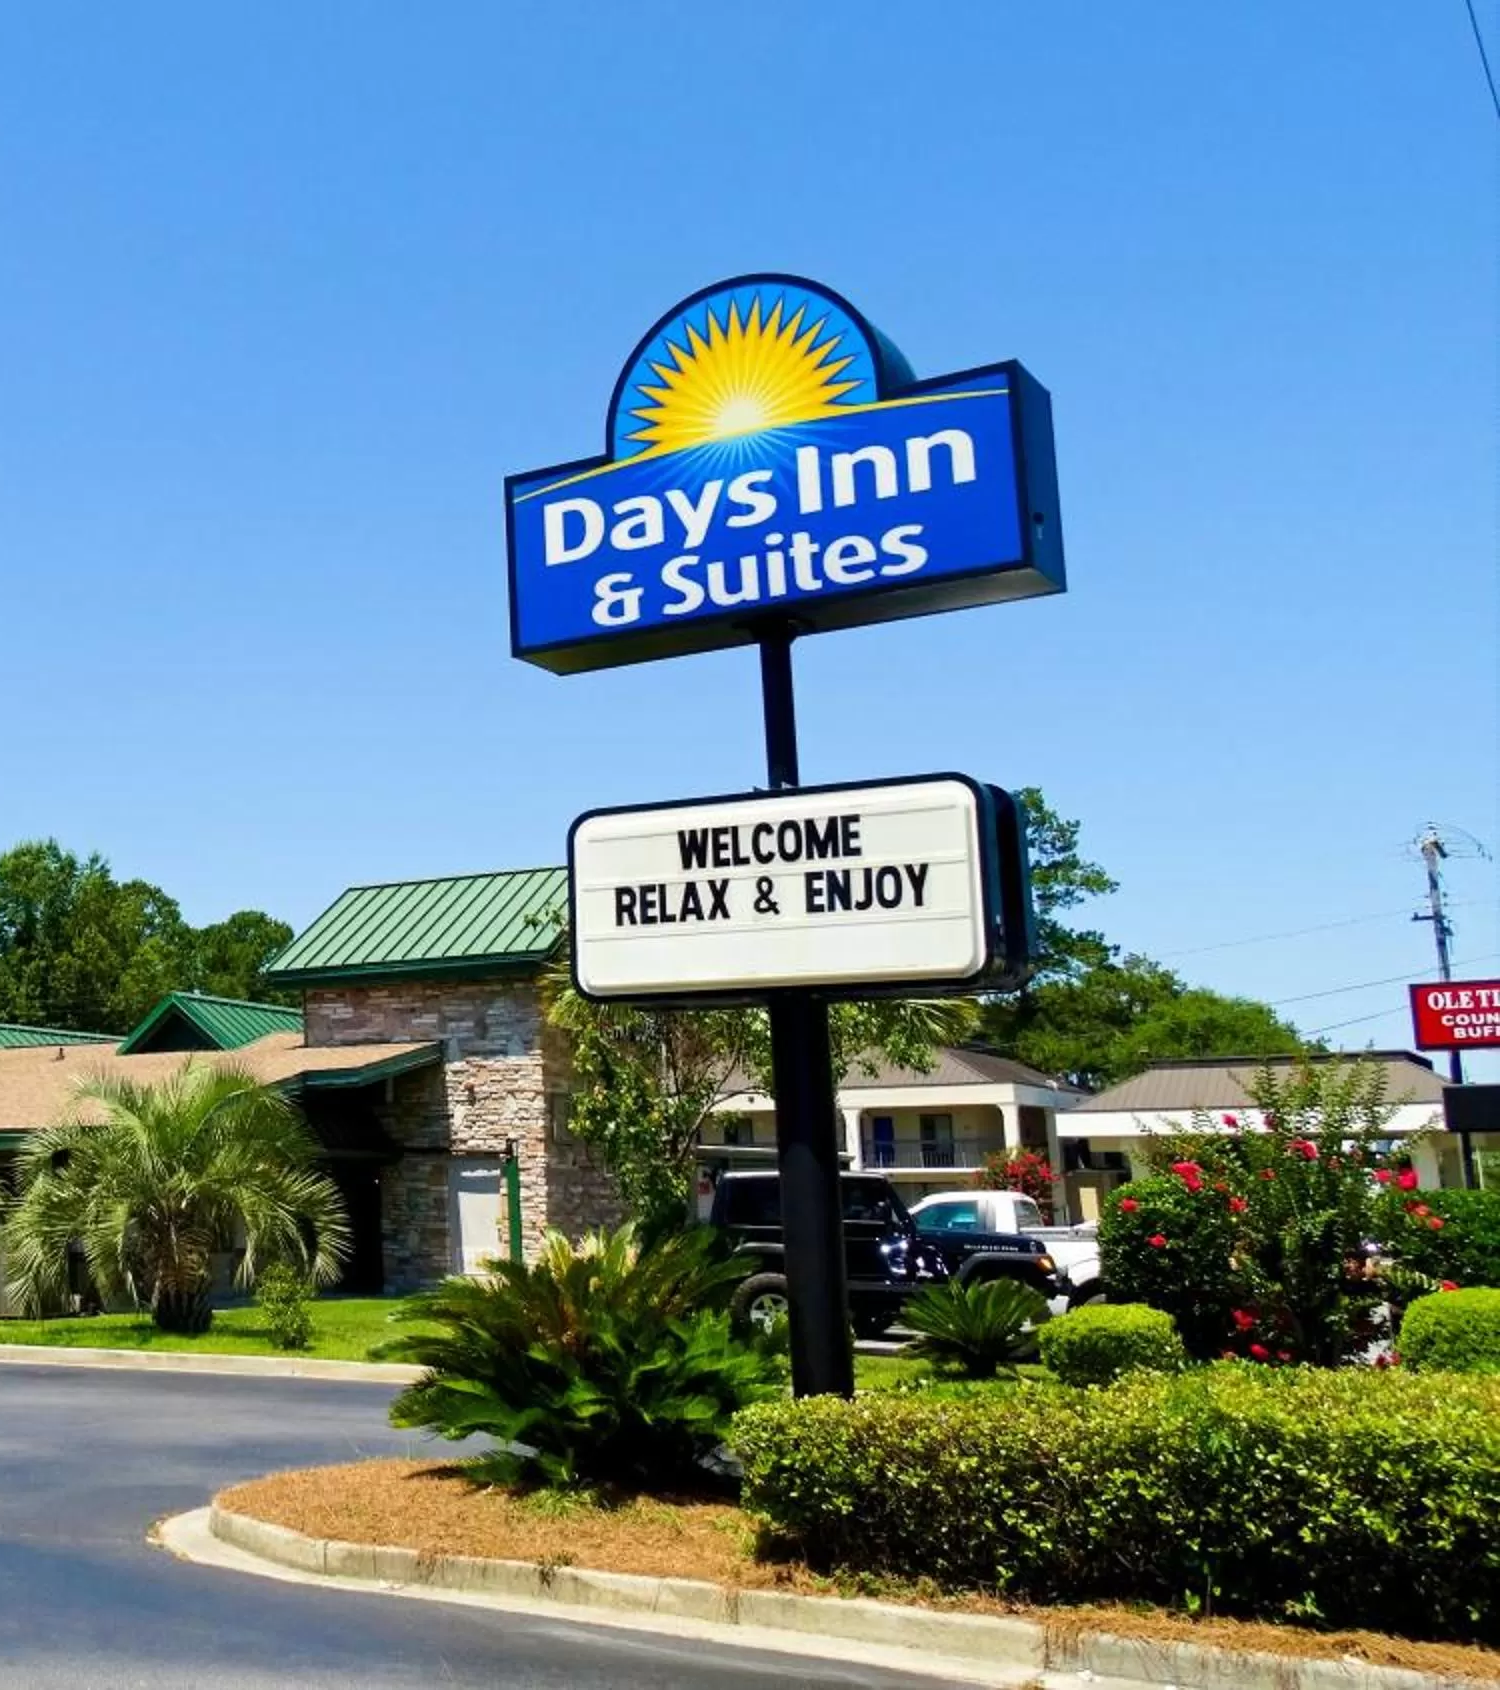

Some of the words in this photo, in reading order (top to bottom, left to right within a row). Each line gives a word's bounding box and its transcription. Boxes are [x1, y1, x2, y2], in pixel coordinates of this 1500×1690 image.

[543, 470, 777, 566] Days
[797, 428, 977, 514] Inn
[591, 573, 643, 626] &
[661, 524, 928, 615] Suites
[677, 813, 862, 870] WELCOME
[614, 878, 731, 927] RELAX
[753, 875, 780, 915] &
[804, 863, 929, 913] ENJOY
[1427, 990, 1475, 1011] OLE
